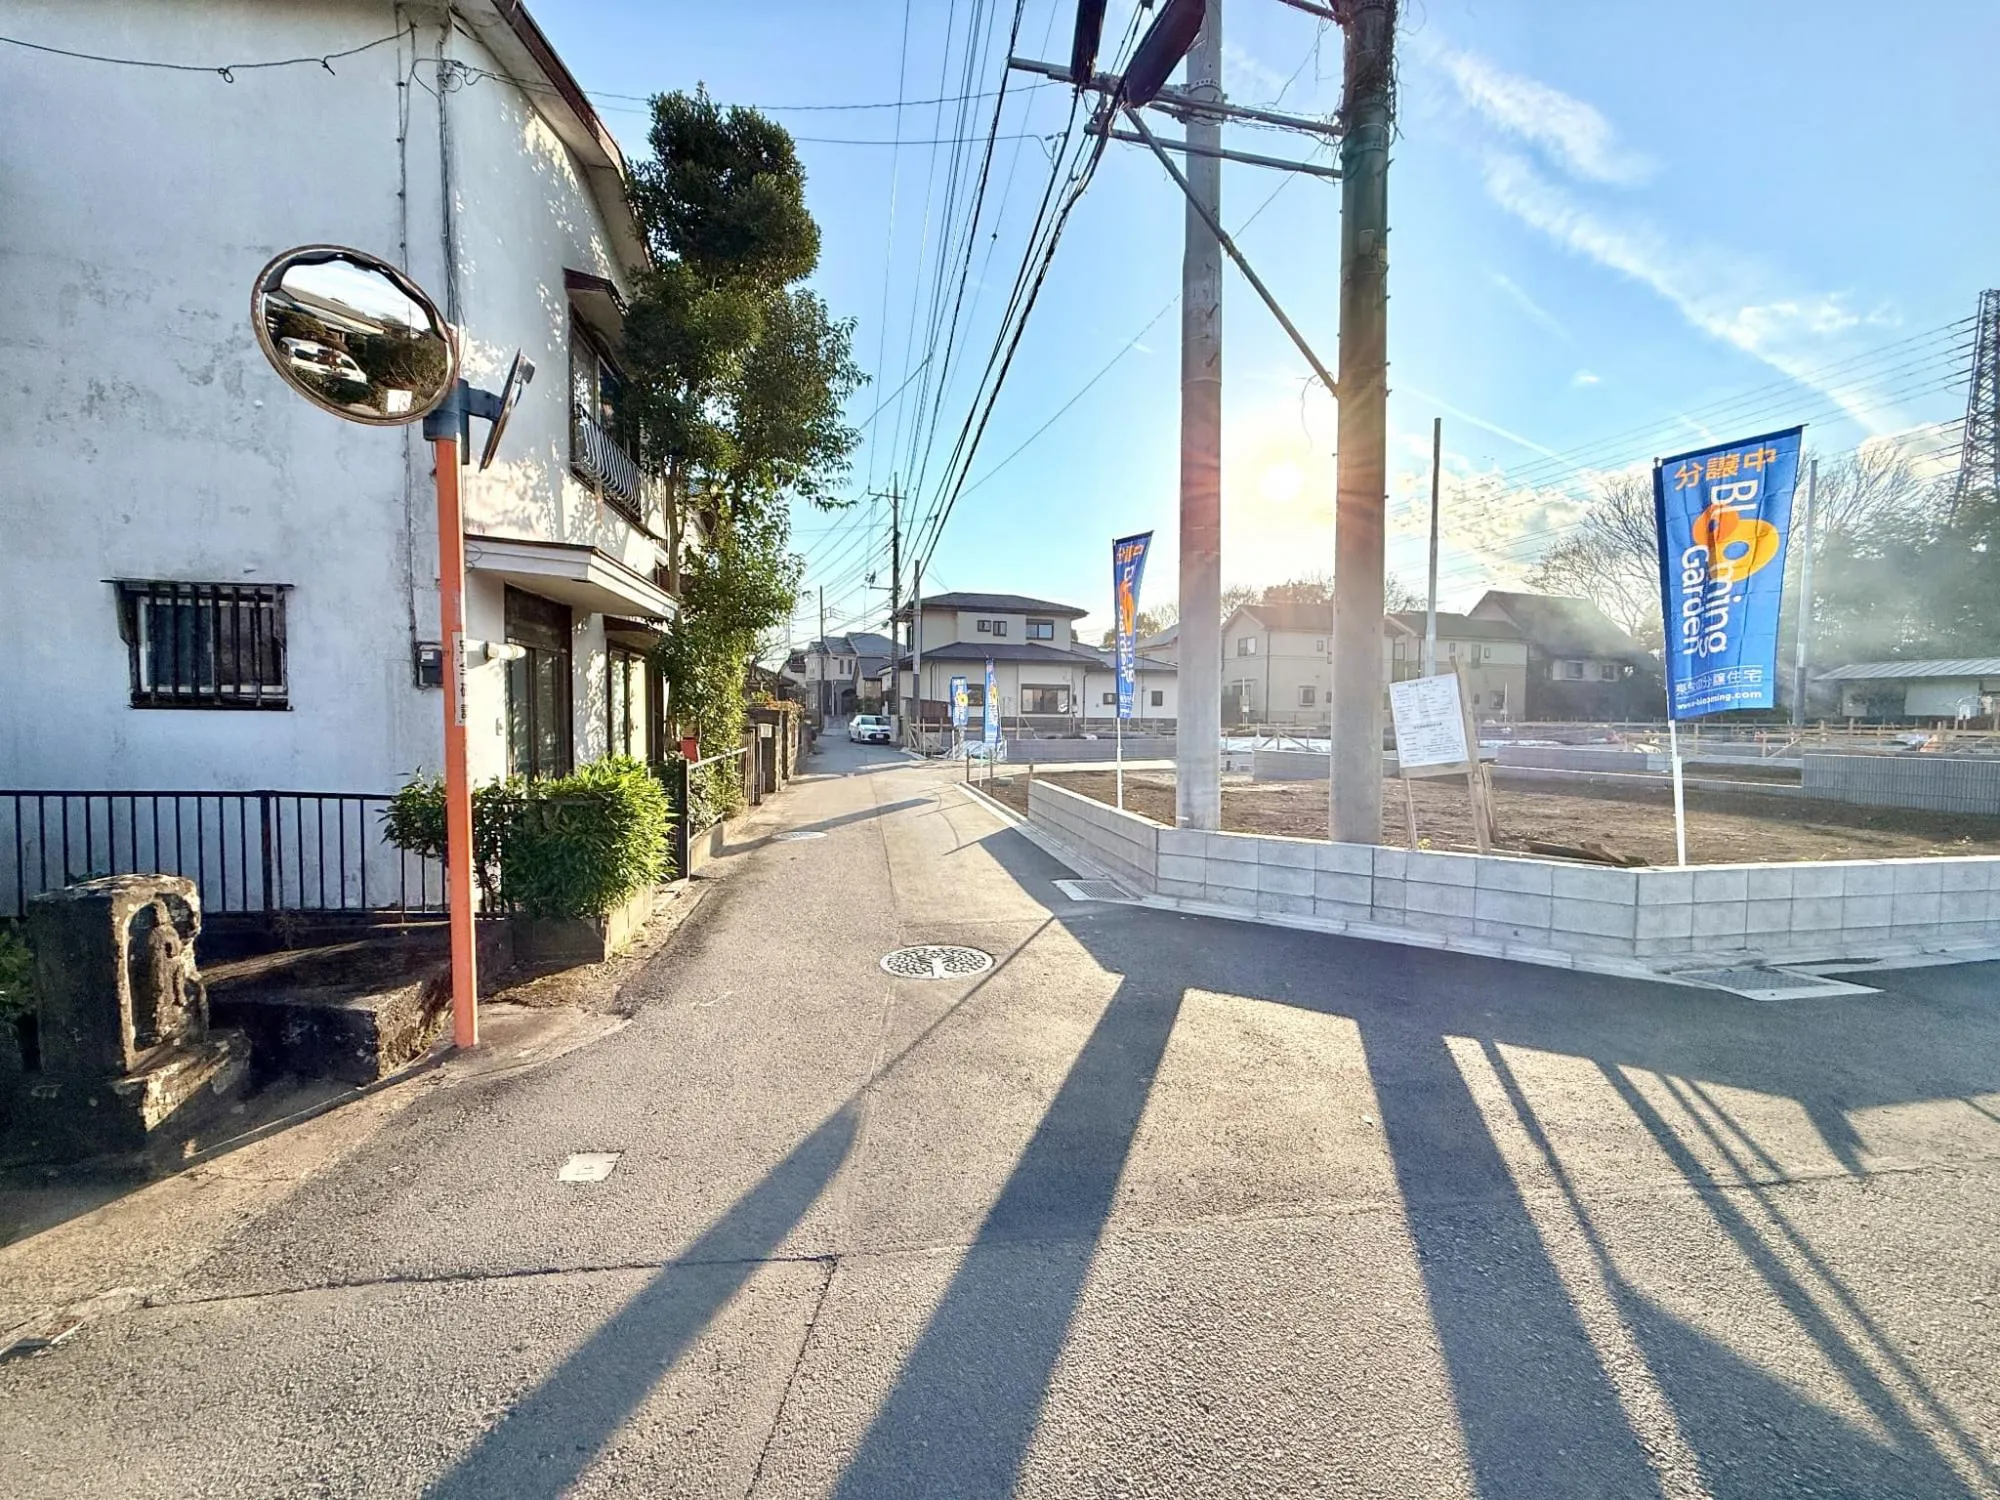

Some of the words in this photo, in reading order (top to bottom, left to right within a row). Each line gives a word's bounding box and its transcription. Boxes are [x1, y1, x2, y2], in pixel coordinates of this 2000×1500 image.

[1675, 448, 1776, 490] 分譲中
[1681, 544, 1708, 656] Garden
